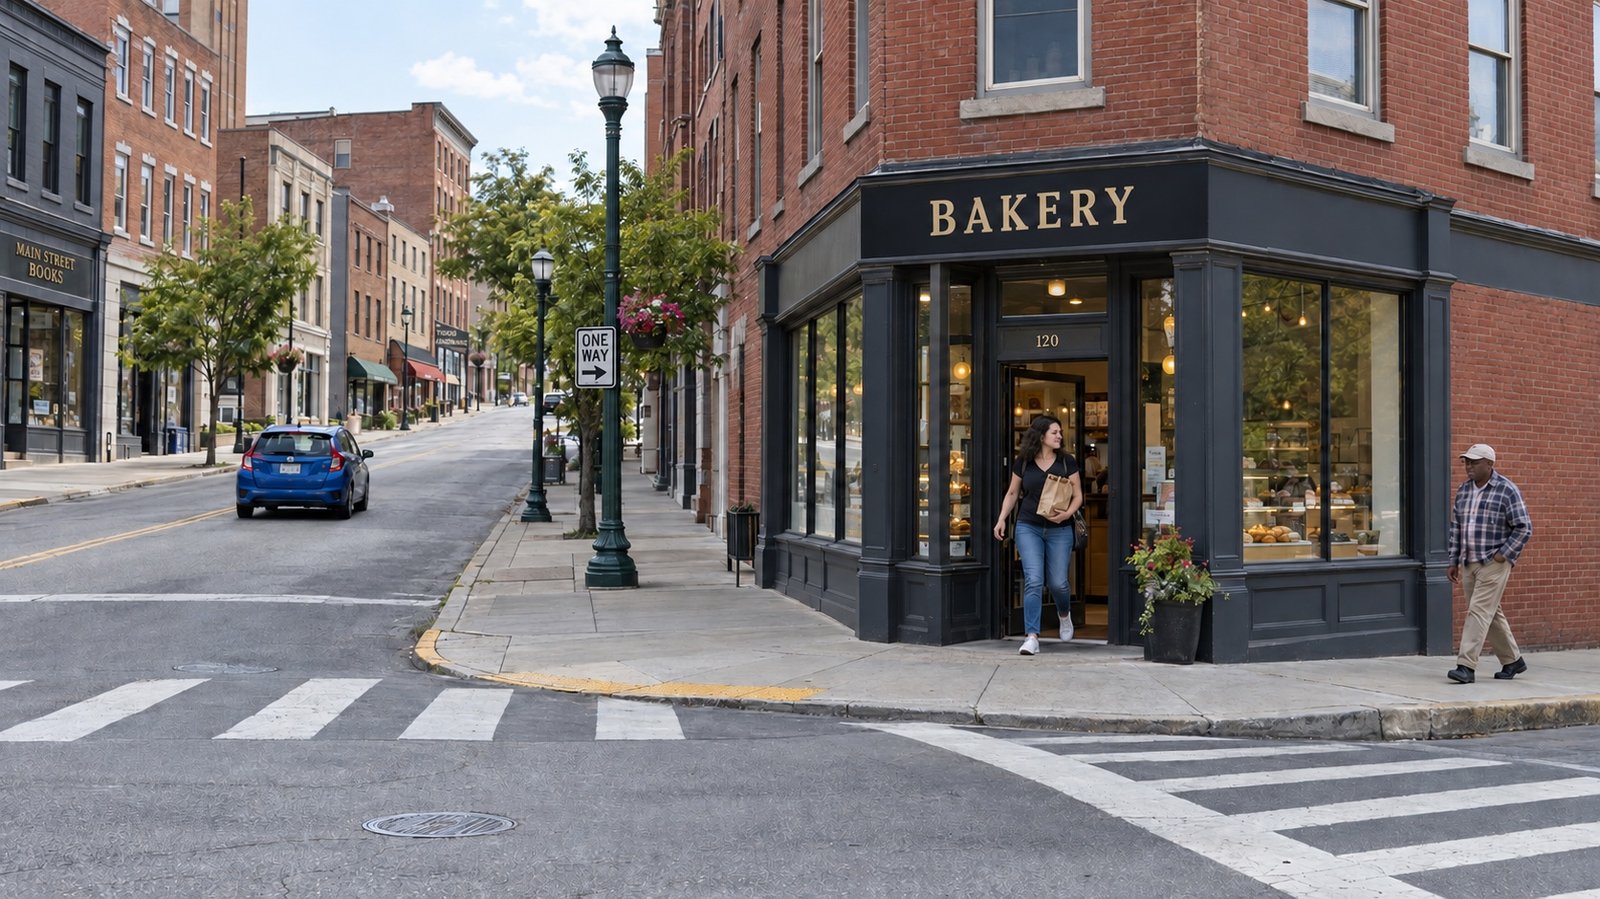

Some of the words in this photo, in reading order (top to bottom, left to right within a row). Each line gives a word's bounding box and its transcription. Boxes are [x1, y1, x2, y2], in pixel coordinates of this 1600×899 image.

[930, 185, 1134, 236] BAKERY
[16, 242, 40, 260] MAIN
[43, 250, 76, 270] STREET
[29, 262, 64, 284] BOOKS
[582, 333, 608, 347] ONE
[1036, 334, 1059, 348] 120
[581, 349, 609, 362] WAY
